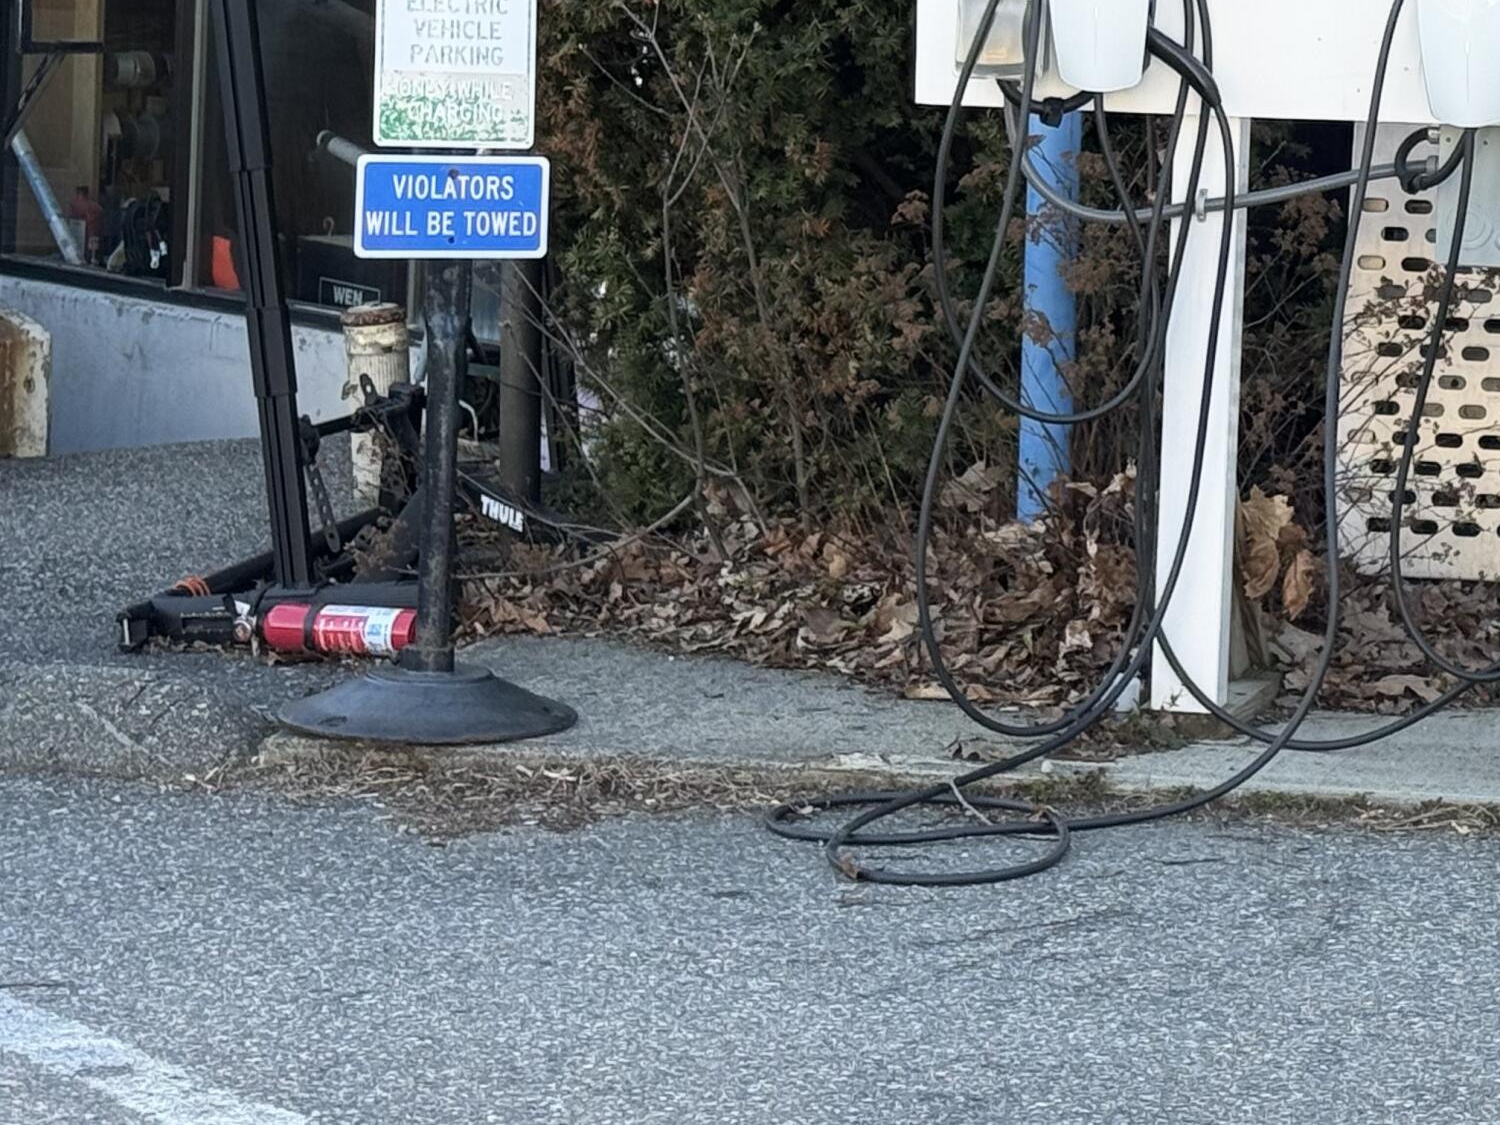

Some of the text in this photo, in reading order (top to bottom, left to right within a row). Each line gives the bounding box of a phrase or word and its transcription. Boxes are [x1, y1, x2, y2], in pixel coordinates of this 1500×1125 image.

[413, 19, 502, 41] VEHICLE
[410, 45, 504, 67] PARKING
[400, 78, 513, 100] ONLY WHILE
[407, 101, 504, 123] CHARGING
[391, 174, 515, 201] VIOLATORS
[366, 211, 537, 237] WILL BE TOWED
[480, 494, 524, 533] THULE
